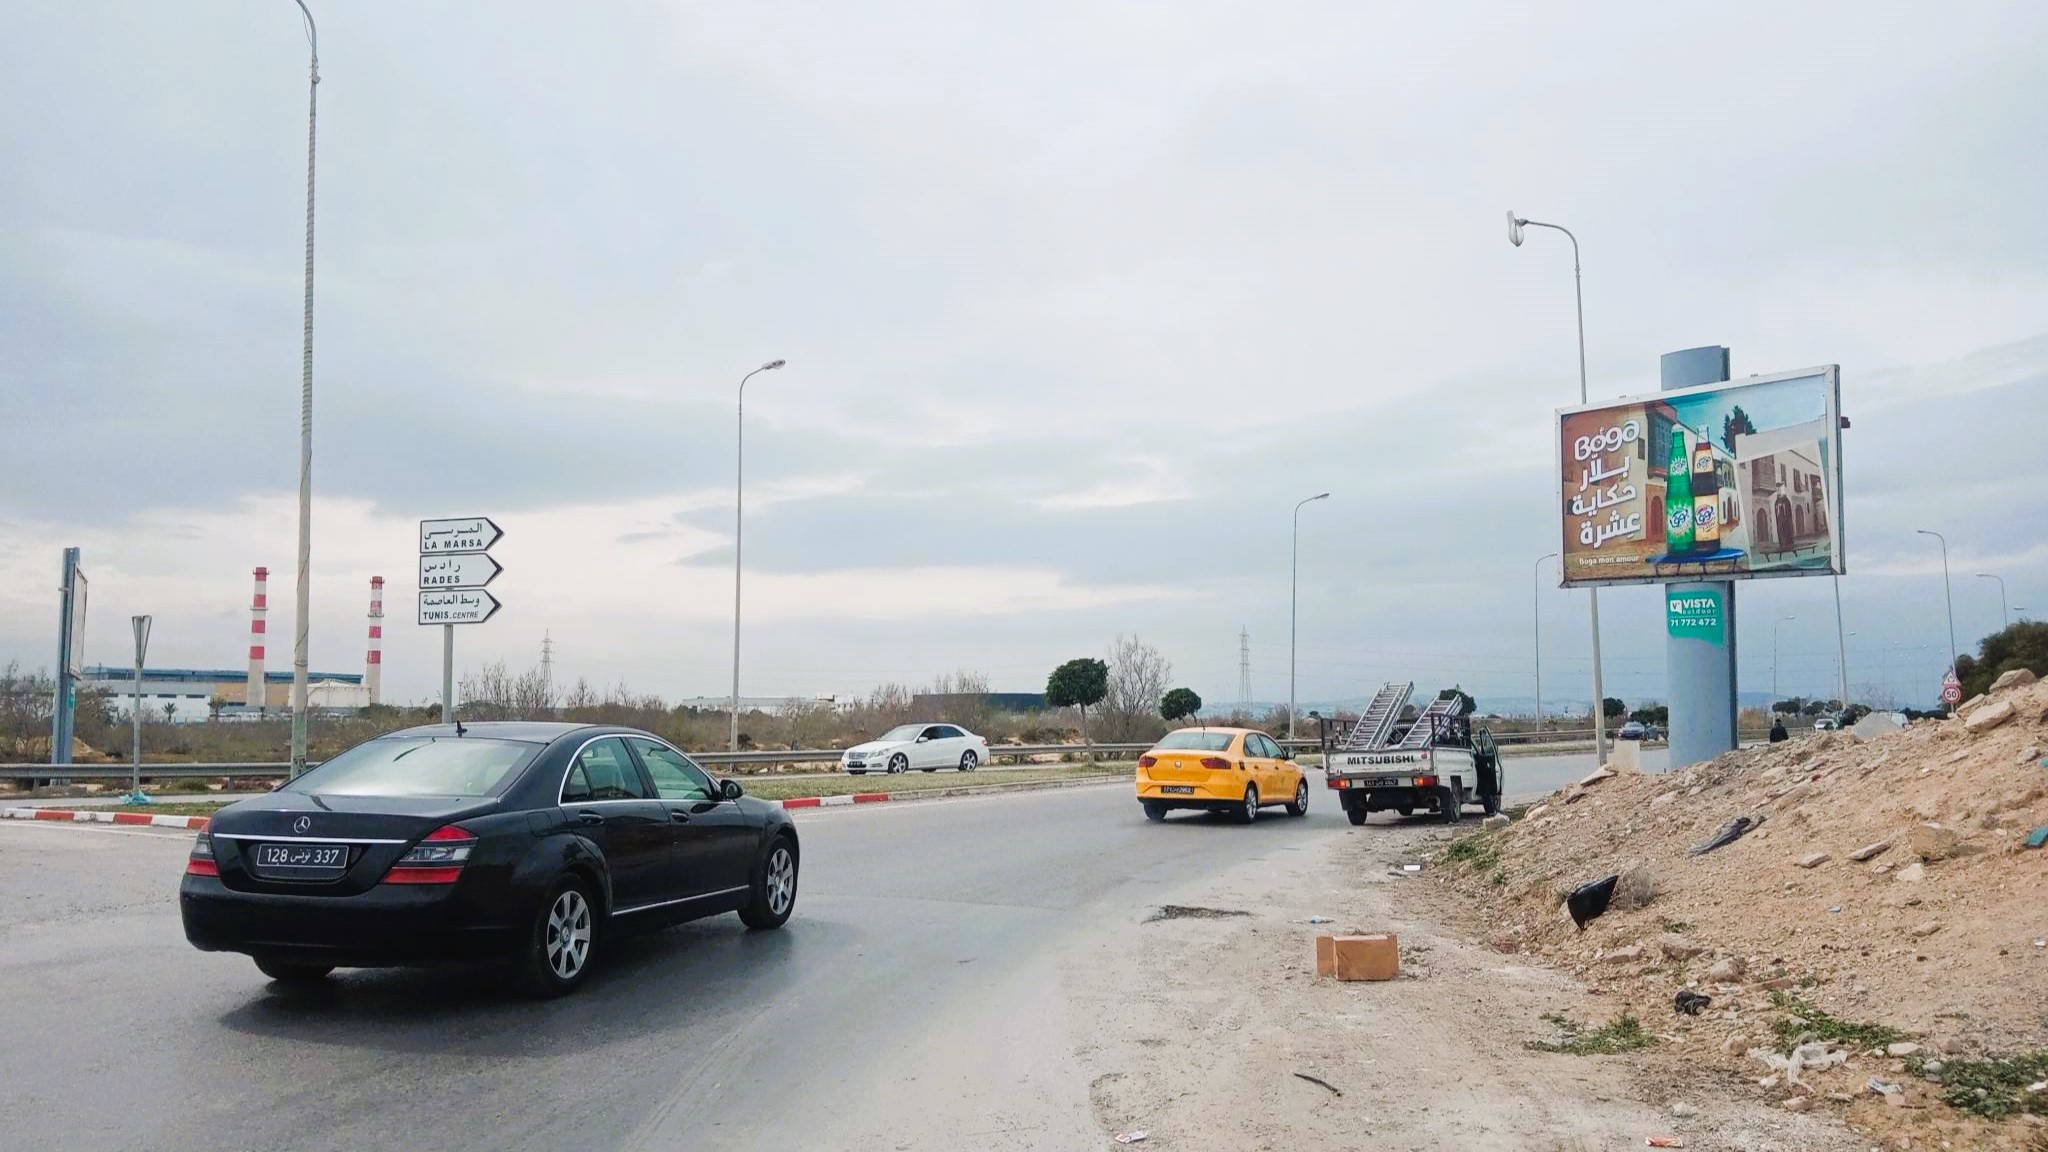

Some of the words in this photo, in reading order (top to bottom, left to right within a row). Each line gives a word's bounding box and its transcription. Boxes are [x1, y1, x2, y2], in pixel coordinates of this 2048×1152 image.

[1572, 483, 1637, 516] حكاية
[424, 541, 438, 550] LA
[444, 539, 482, 549] MARSA
[424, 559, 461, 573] رادس
[1579, 558, 1597, 566] Boga
[423, 575, 460, 584] RADES
[423, 594, 458, 606] العاصمة
[460, 594, 480, 607] وسط
[1682, 598, 1716, 609] VISTA
[452, 611, 479, 619] CENTRE
[1670, 619, 1679, 627] 71
[1698, 618, 1717, 626] 472
[1946, 691, 1957, 699] 50
[1347, 755, 1415, 765] MITSUBISHI
[267, 848, 289, 862] 128
[290, 848, 311, 864] تونس
[313, 849, 340, 864] 337
